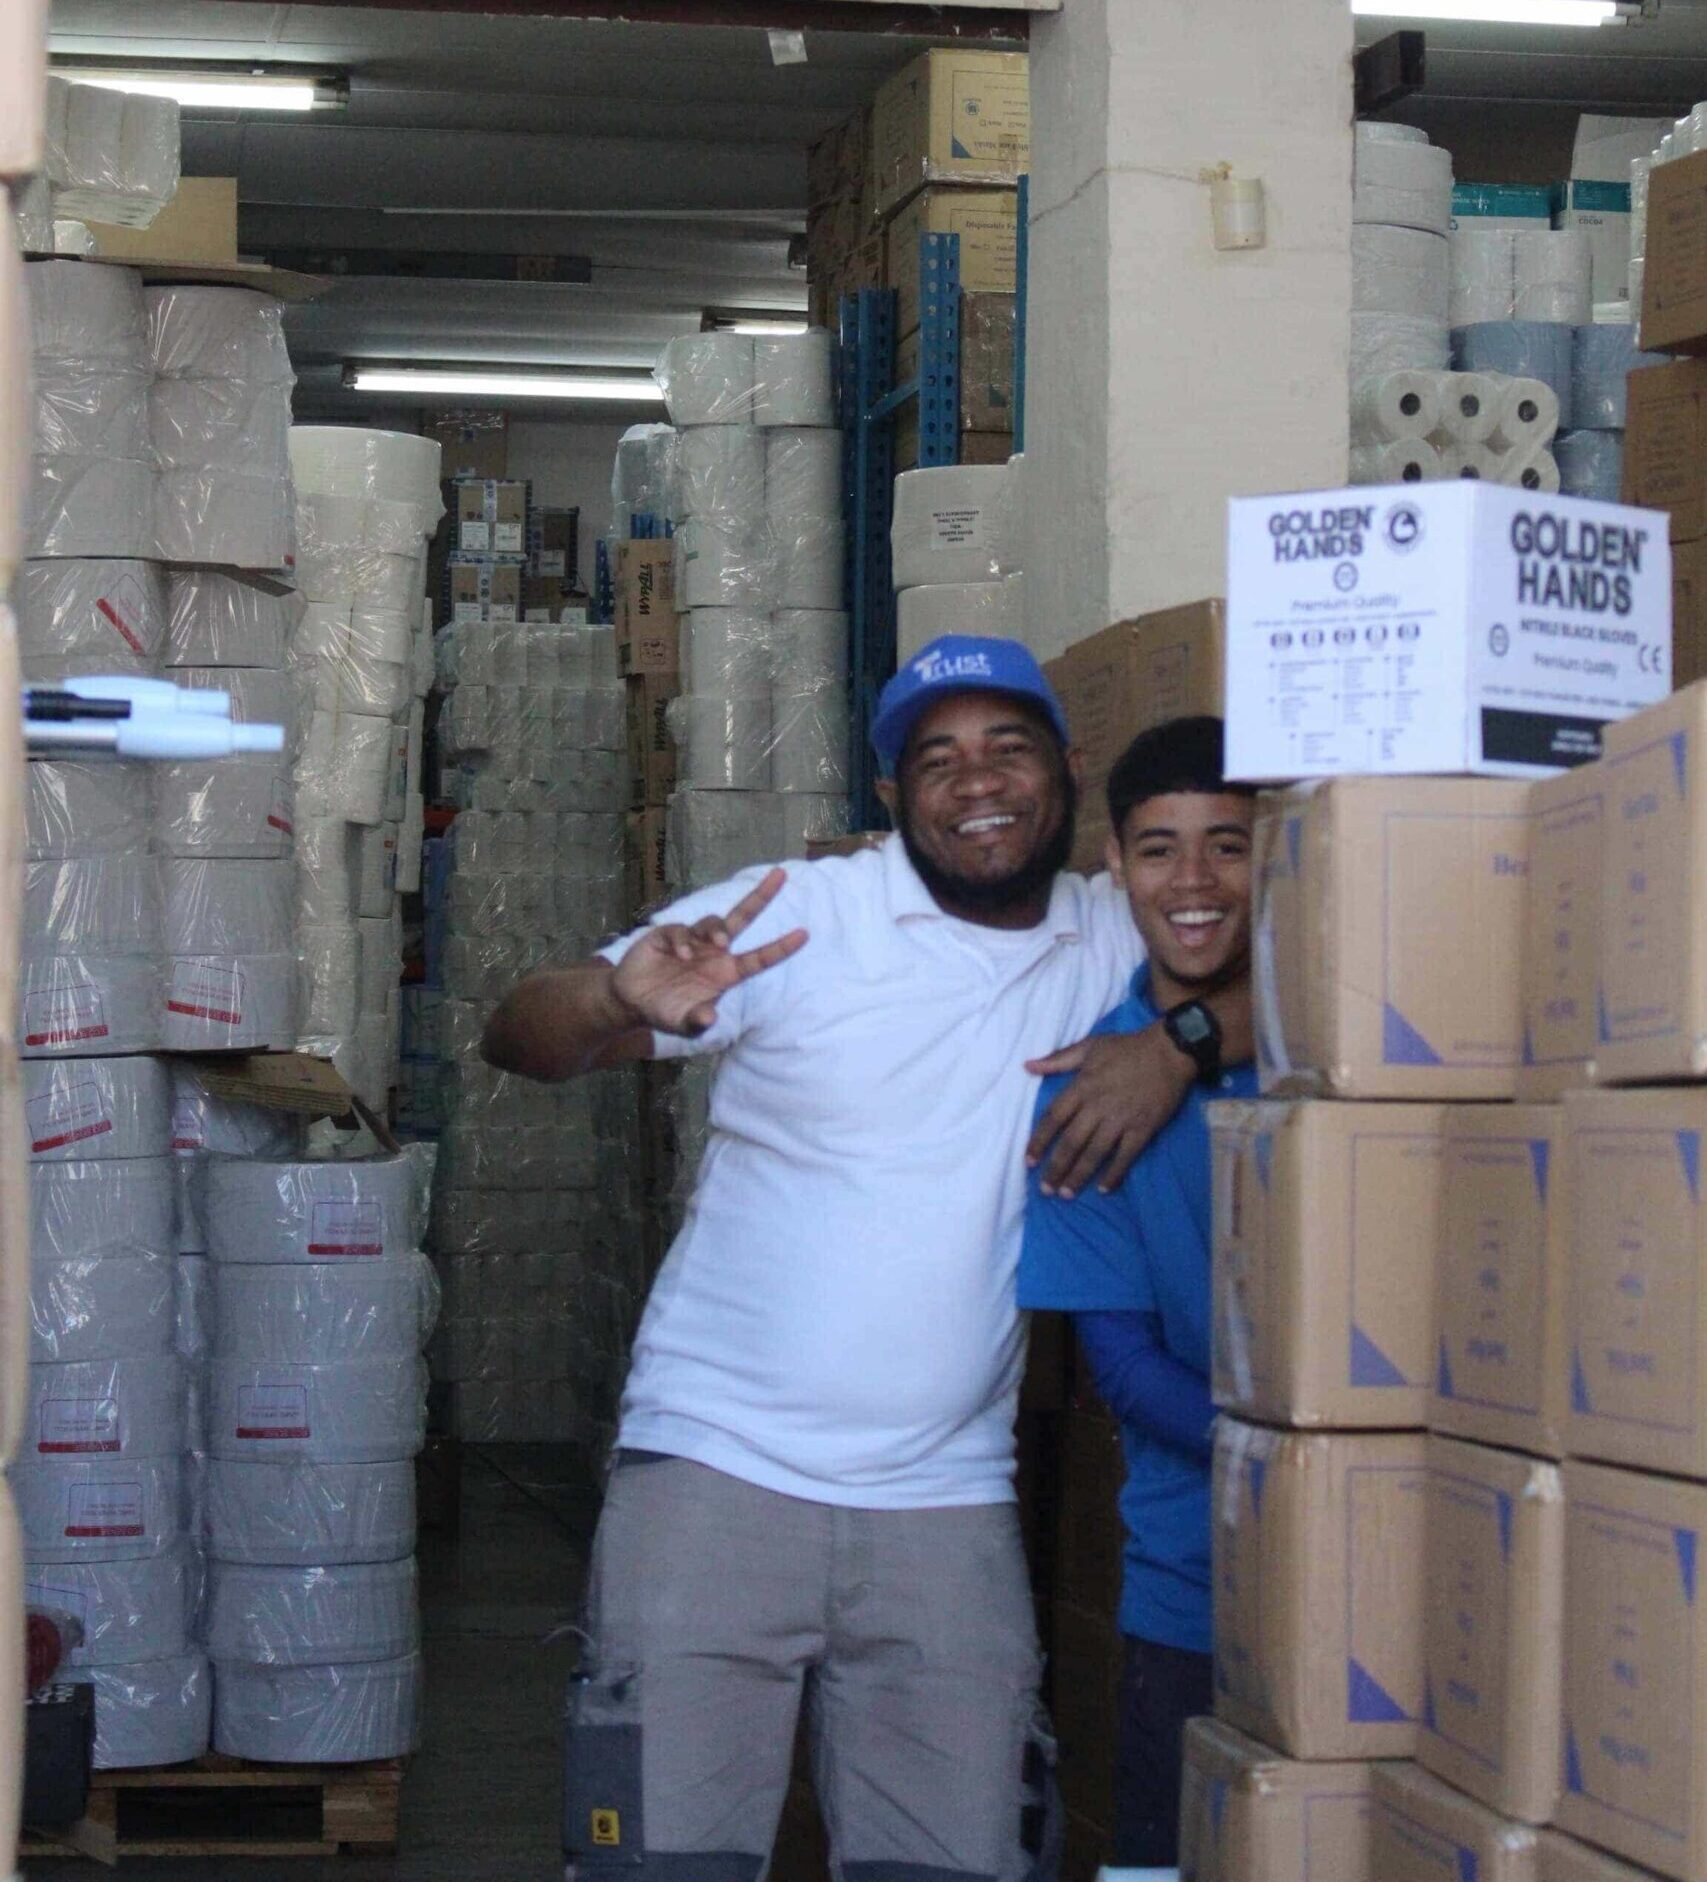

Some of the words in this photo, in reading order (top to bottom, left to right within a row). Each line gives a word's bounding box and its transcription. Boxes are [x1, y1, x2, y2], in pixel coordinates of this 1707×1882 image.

[1269, 506, 1372, 537] GOLDEN
[1274, 532, 1363, 562] HANDS
[1510, 511, 1643, 574] GOLDEN
[1518, 557, 1632, 616] HANDS
[1561, 625, 1594, 641] BLACK
